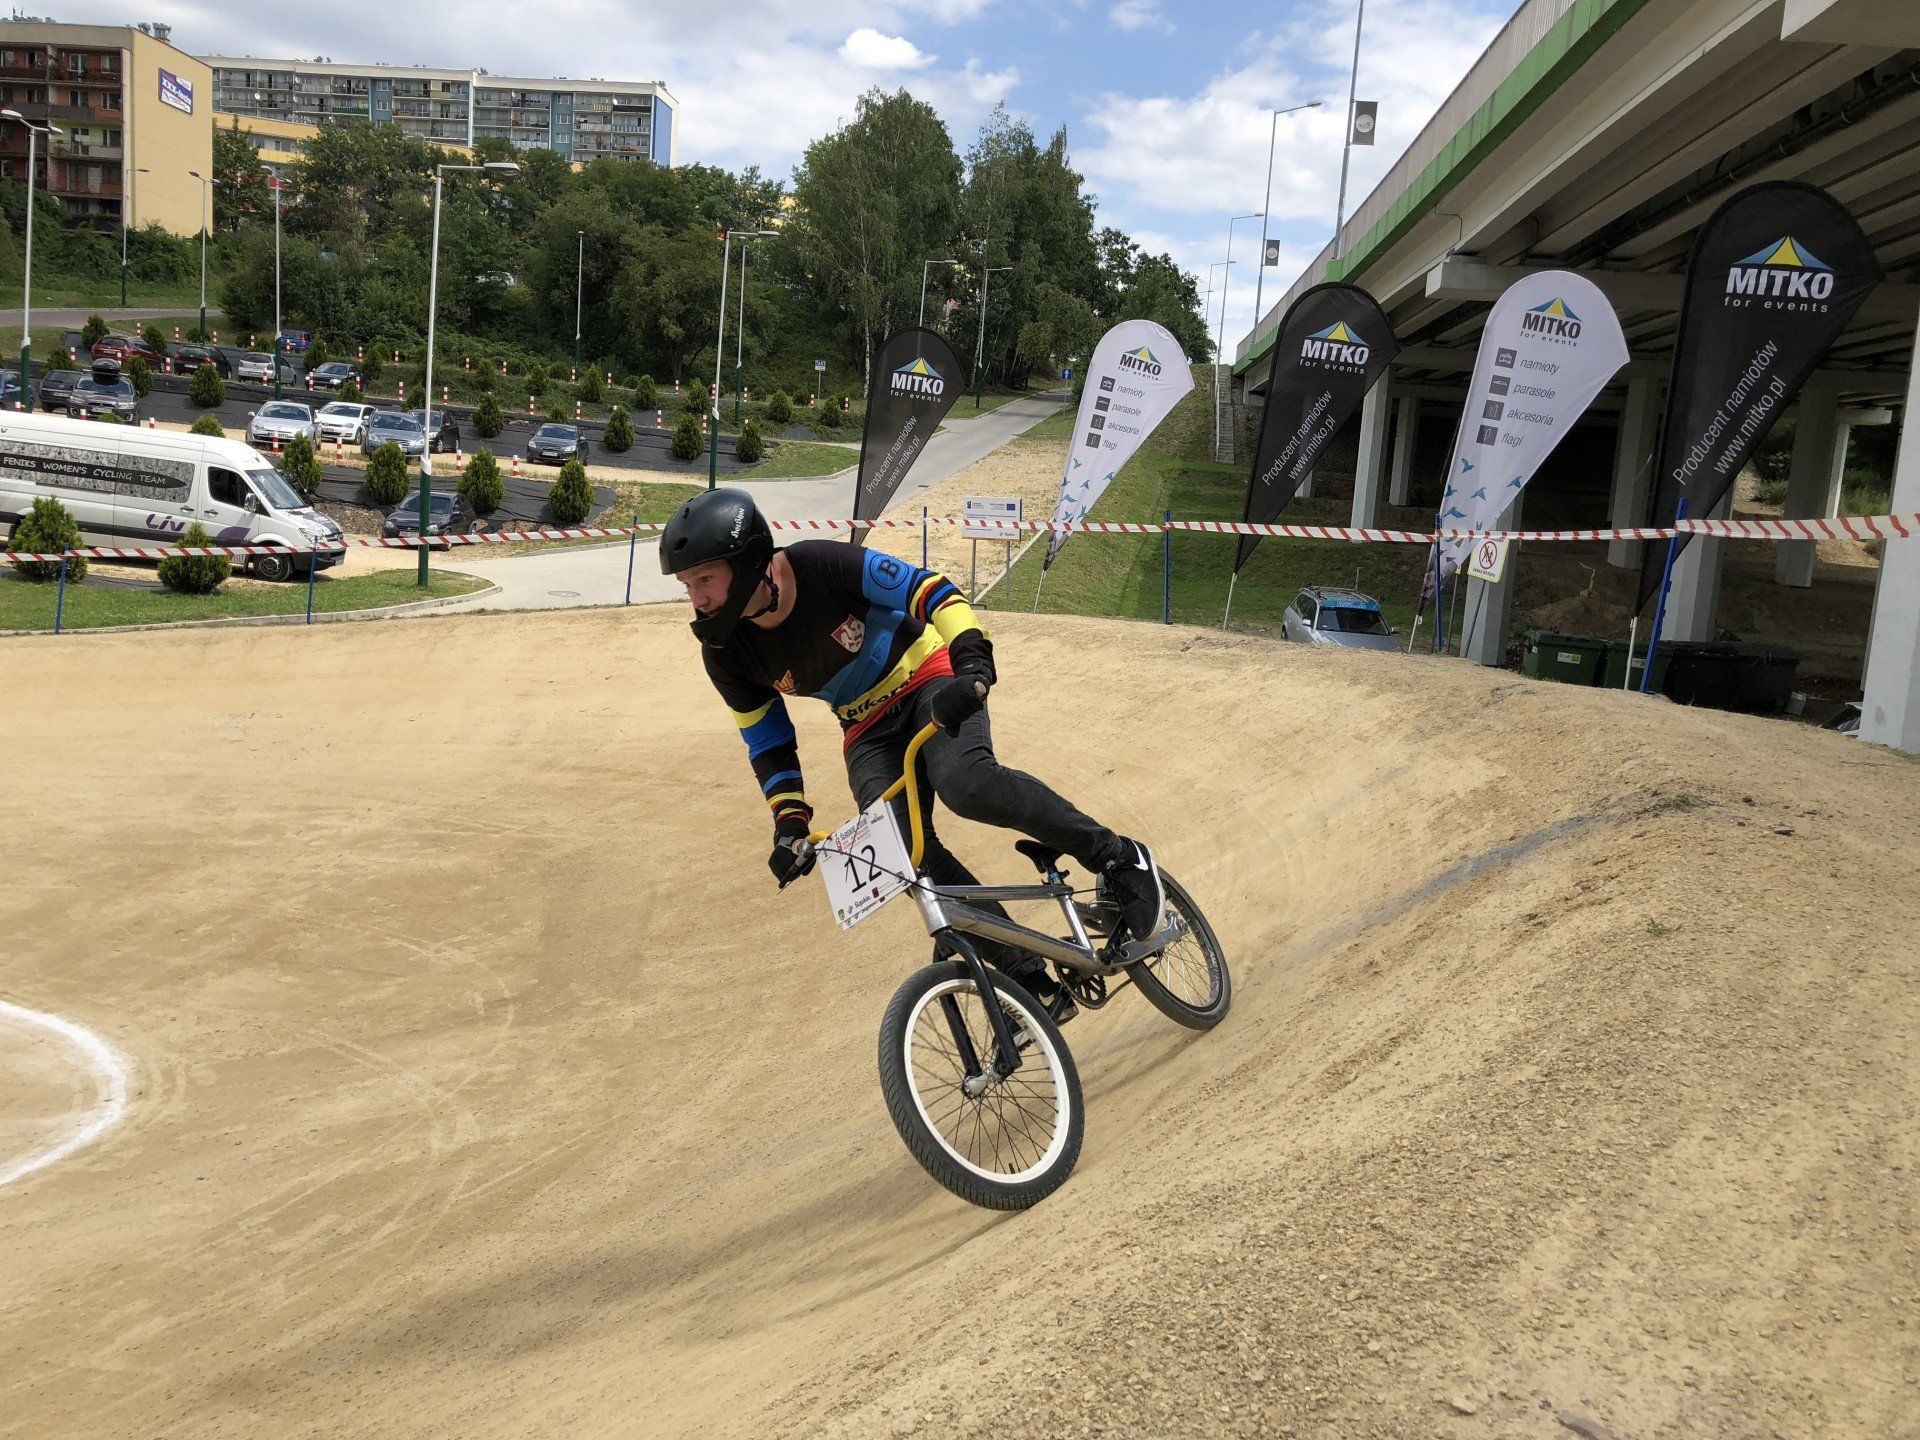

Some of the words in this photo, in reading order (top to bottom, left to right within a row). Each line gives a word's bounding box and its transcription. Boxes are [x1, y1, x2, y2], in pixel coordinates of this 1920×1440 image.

[1726, 267, 1834, 300] MITKO
[1724, 297, 1751, 307] for
[1764, 299, 1829, 313] events
[1522, 312, 1582, 340] MITKO
[1520, 330, 1535, 339] for
[1541, 336, 1578, 347] events
[1301, 339, 1370, 365] MITKO
[1120, 353, 1161, 376] MITKO
[1299, 358, 1317, 367] for
[1324, 363, 1365, 374] events
[1520, 359, 1560, 376] namioty
[891, 372, 944, 395] MITKO
[1133, 371, 1159, 381] events
[909, 393, 942, 403] events
[1117, 385, 1145, 398] namioty
[1512, 383, 1556, 399] parasole
[1111, 403, 1142, 416] parasole
[1507, 408, 1554, 426] akcesoria
[1673, 409, 1731, 485] Producent
[1725, 340, 1778, 413] namiotów
[1107, 421, 1140, 435] akcesoria
[1714, 374, 1787, 475] www.mitko.pl
[1262, 435, 1301, 486] Producent
[1298, 391, 1333, 439] namiotów
[1288, 414, 1336, 480] www.mitko.pl
[1501, 432, 1523, 447] flagi
[865, 452, 895, 494] Producent
[891, 416, 917, 455] namiotów
[885, 436, 920, 488] www.mitko.pl
[3, 456, 36, 468] FENIKS
[42, 461, 88, 475] WOMEN'S
[93, 468, 133, 481] CYCLING
[138, 474, 166, 485] TEAM
[145, 513, 186, 532] Liv
[844, 844, 882, 893] 12
